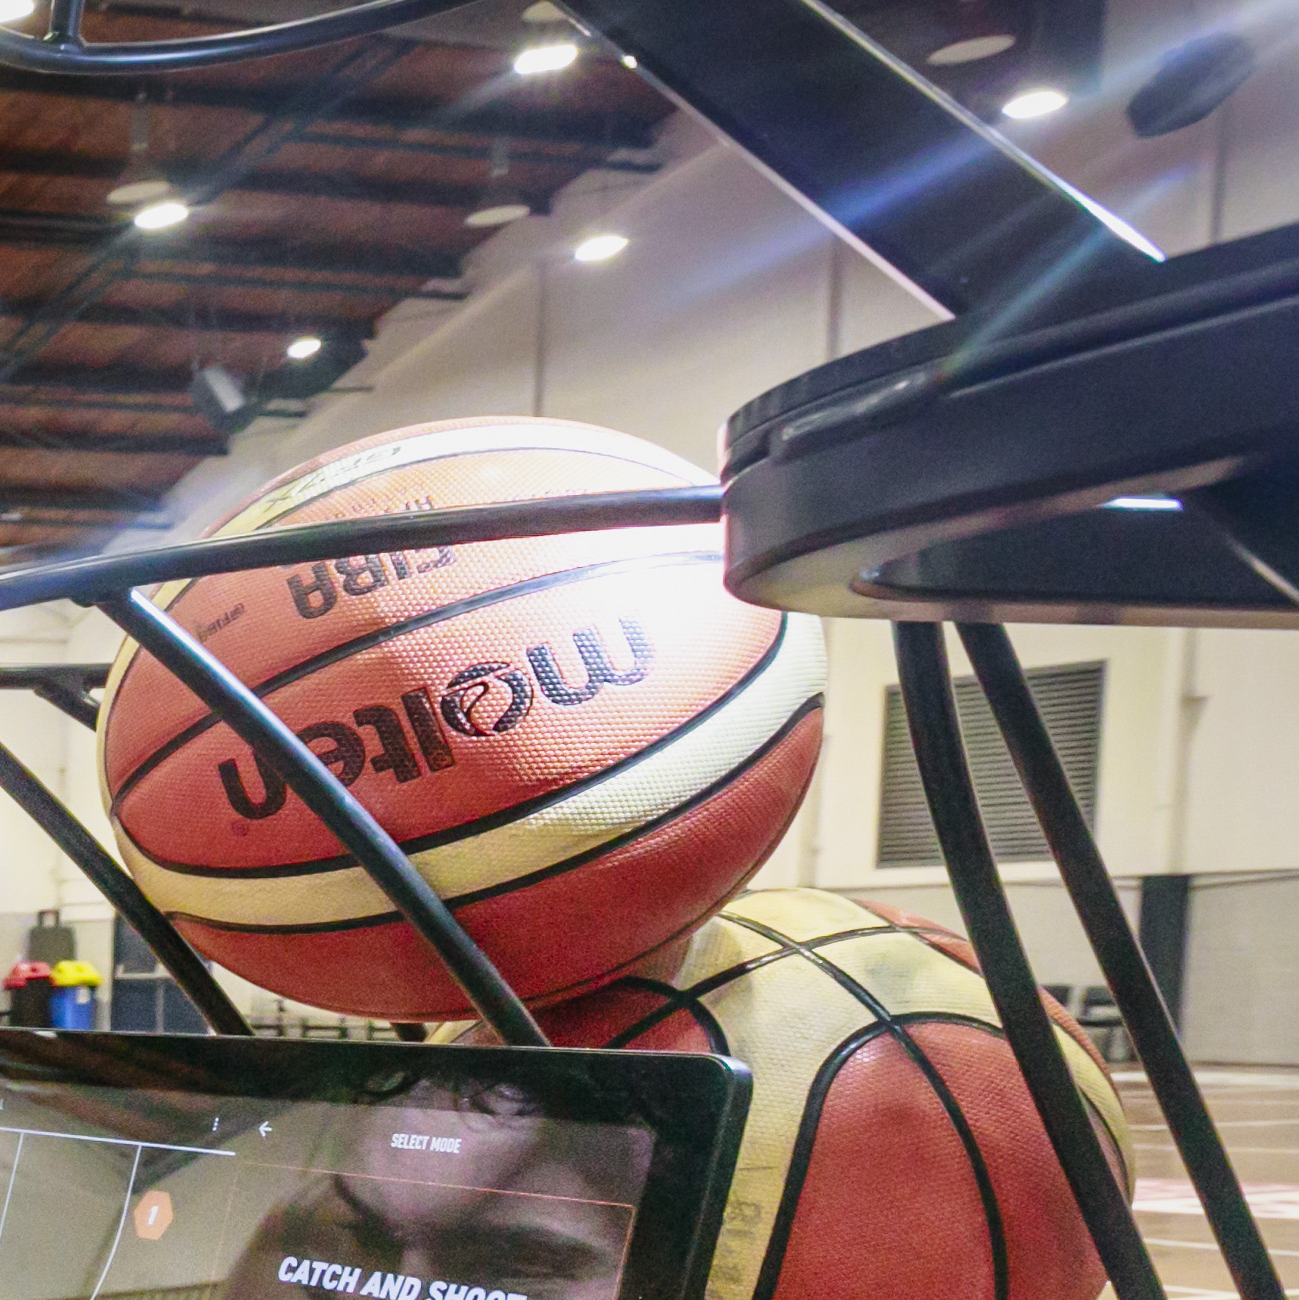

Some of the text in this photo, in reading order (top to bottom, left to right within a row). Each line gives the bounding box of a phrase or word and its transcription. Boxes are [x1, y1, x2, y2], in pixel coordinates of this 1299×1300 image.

[390, 1133, 462, 1153] SELECT MODE
[148, 1205, 160, 1225] 1
[277, 1256, 362, 1293] CATCH
